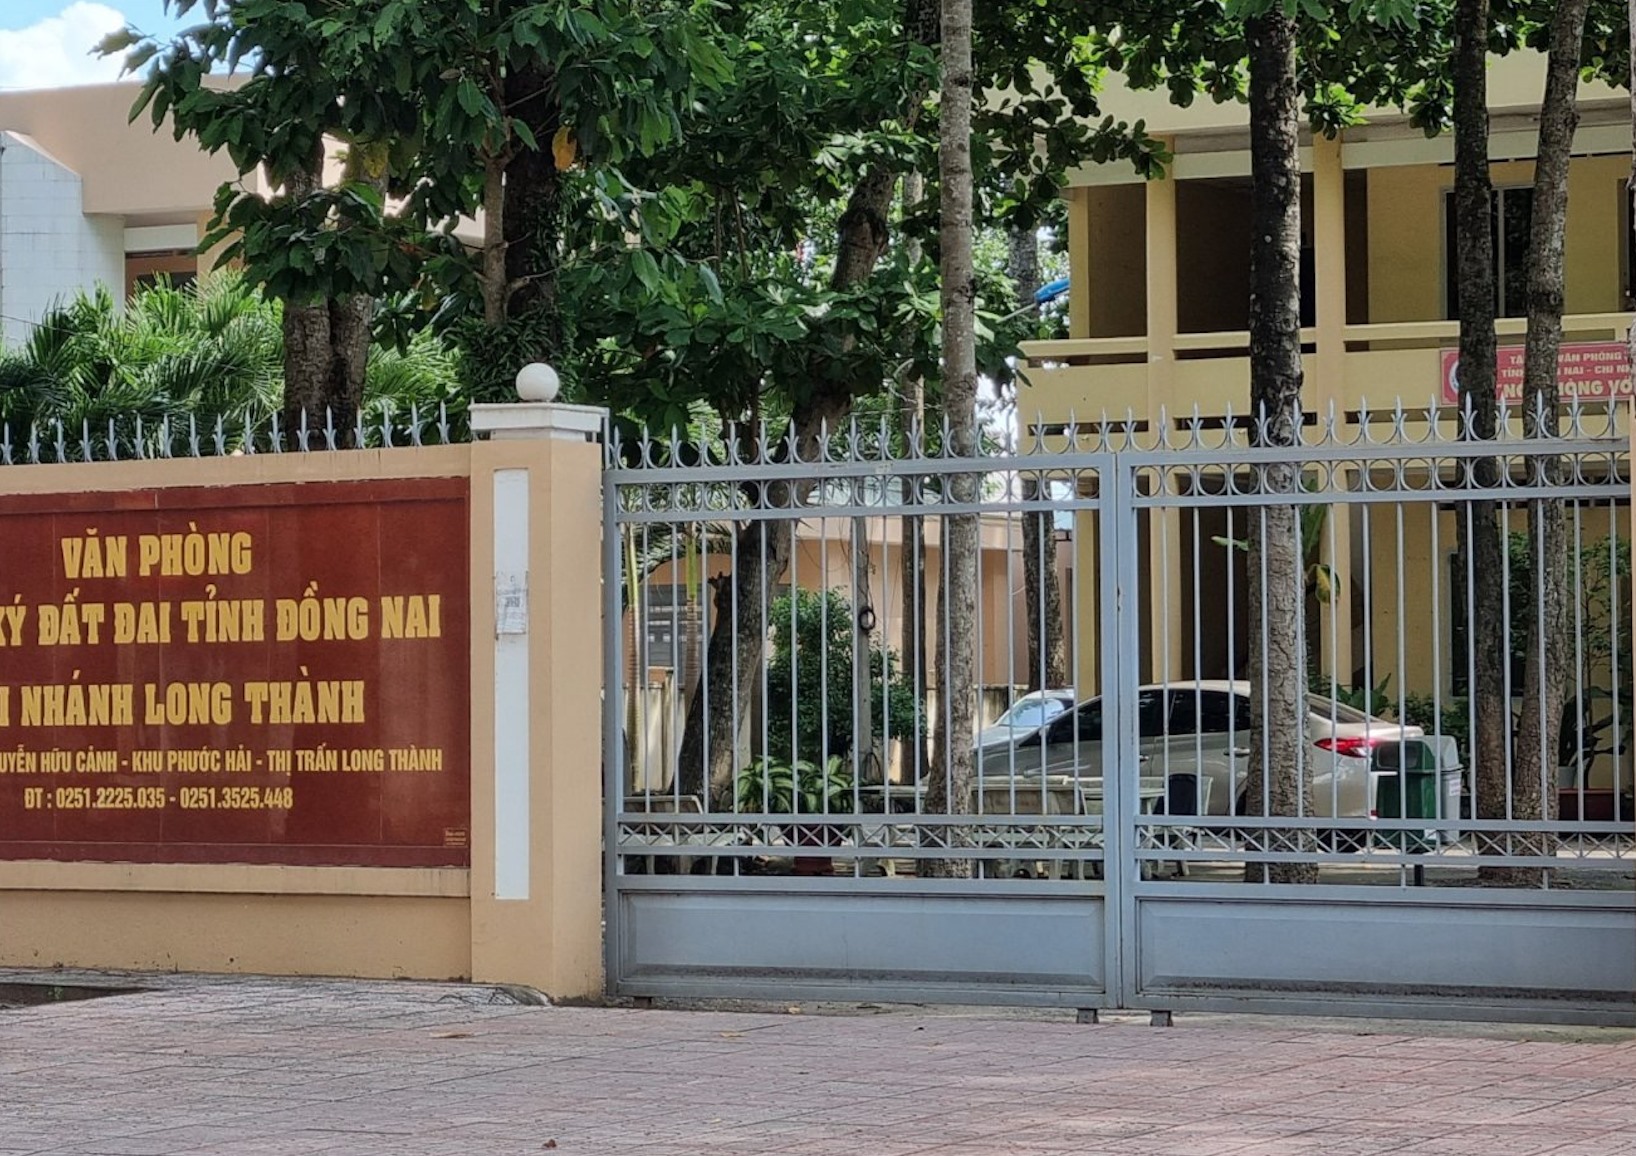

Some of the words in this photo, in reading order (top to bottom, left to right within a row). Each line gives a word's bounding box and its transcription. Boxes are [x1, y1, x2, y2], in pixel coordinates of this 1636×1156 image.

[61, 528, 127, 578] VĂN
[139, 521, 251, 576] PHÒNG
[0, 593, 26, 646] Ý
[38, 587, 104, 645] ĐẤT
[114, 602, 171, 644] ĐAI
[181, 584, 264, 642] TỈNH
[276, 580, 368, 641] ĐỒNG
[381, 594, 440, 639] NAI
[21, 669, 133, 726] NHÁNH
[145, 682, 232, 725] LONG
[244, 666, 364, 724] THÀNH
[40, 748, 71, 772] HỮU
[76, 745, 117, 772] CẢNH
[132, 750, 162, 772] KHU
[167, 746, 220, 771] PHƯỚC
[225, 744, 251, 771] HẢI
[267, 750, 291, 776] THỊ
[296, 742, 337, 771] TRẤN
[342, 749, 384, 771] LONG
[389, 744, 442, 771] THÀNH
[24, 788, 43, 808] ĐT
[56, 787, 165, 809] 0251.2225.035
[180, 787, 293, 809] 0251.3525.448
